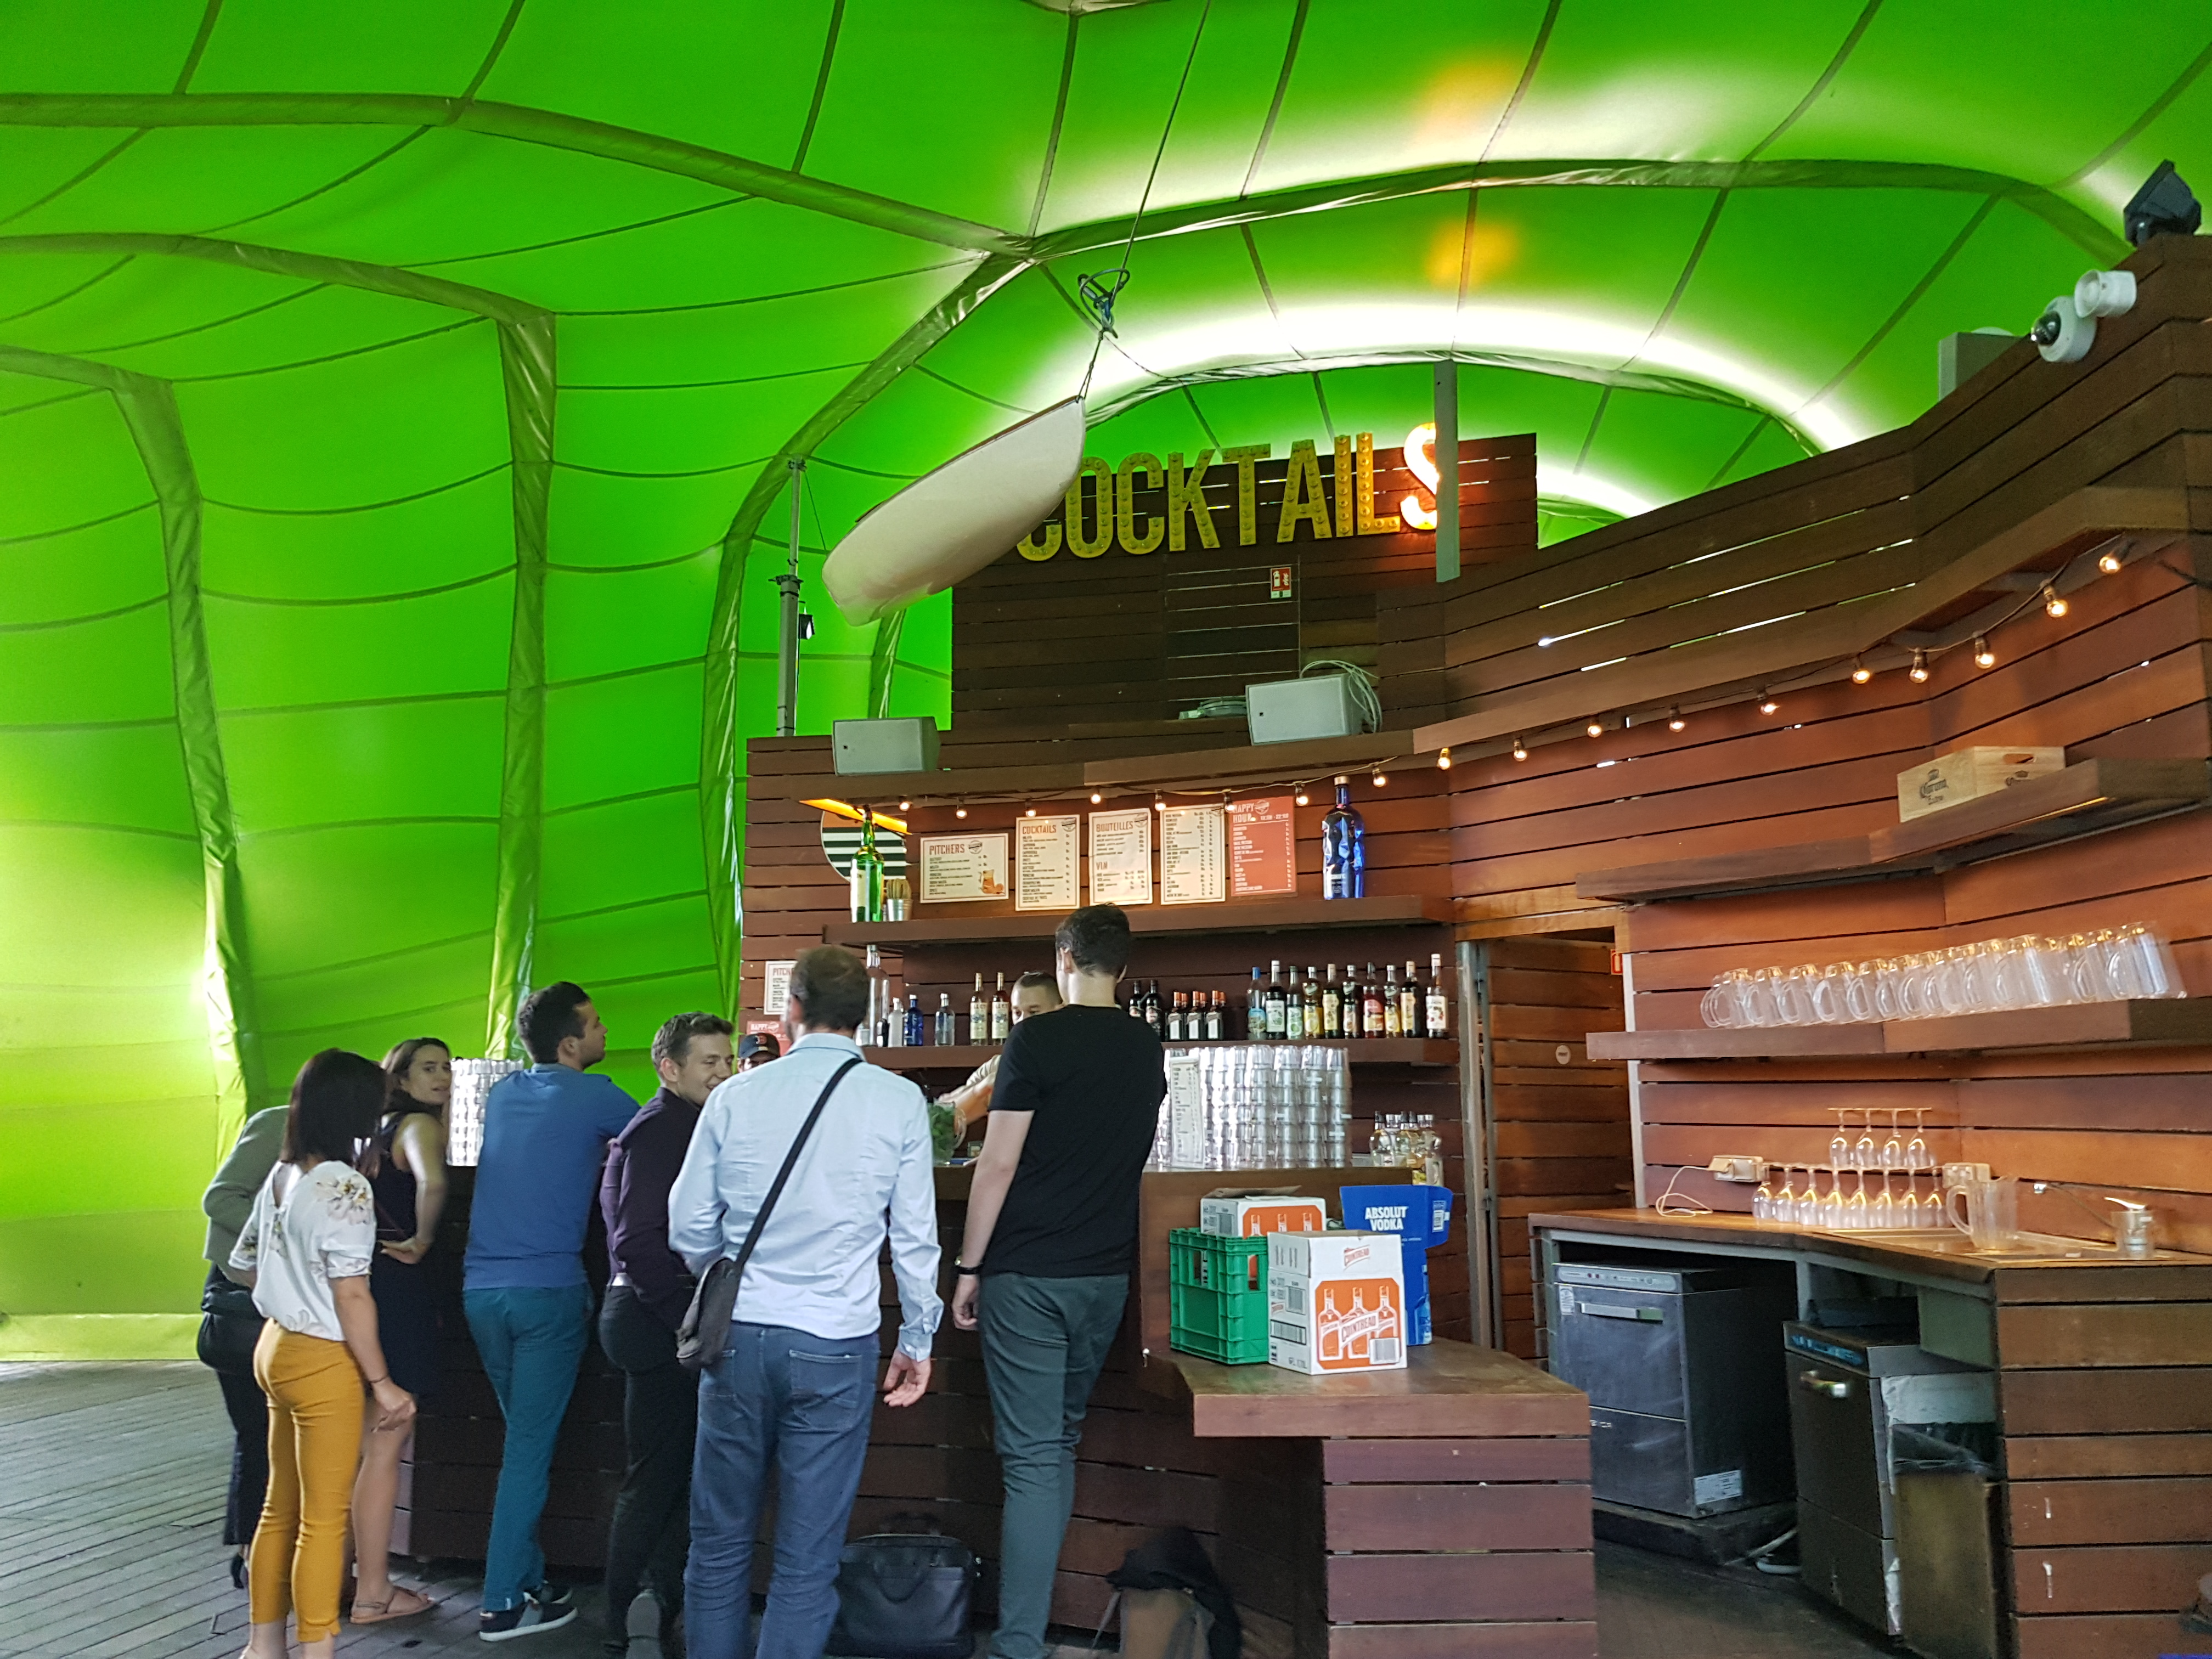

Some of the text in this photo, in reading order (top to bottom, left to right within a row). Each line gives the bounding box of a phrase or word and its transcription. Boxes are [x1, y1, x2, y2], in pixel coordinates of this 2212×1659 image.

[1022, 825, 1057, 834] COCKTAILS
[1096, 821, 1133, 832] BOUTEILLES
[929, 843, 966, 855] PITCHERS
[1096, 861, 1108, 871] VIN
[1364, 1206, 1409, 1220] ABSOLUT
[1369, 1218, 1404, 1232] VODKA
